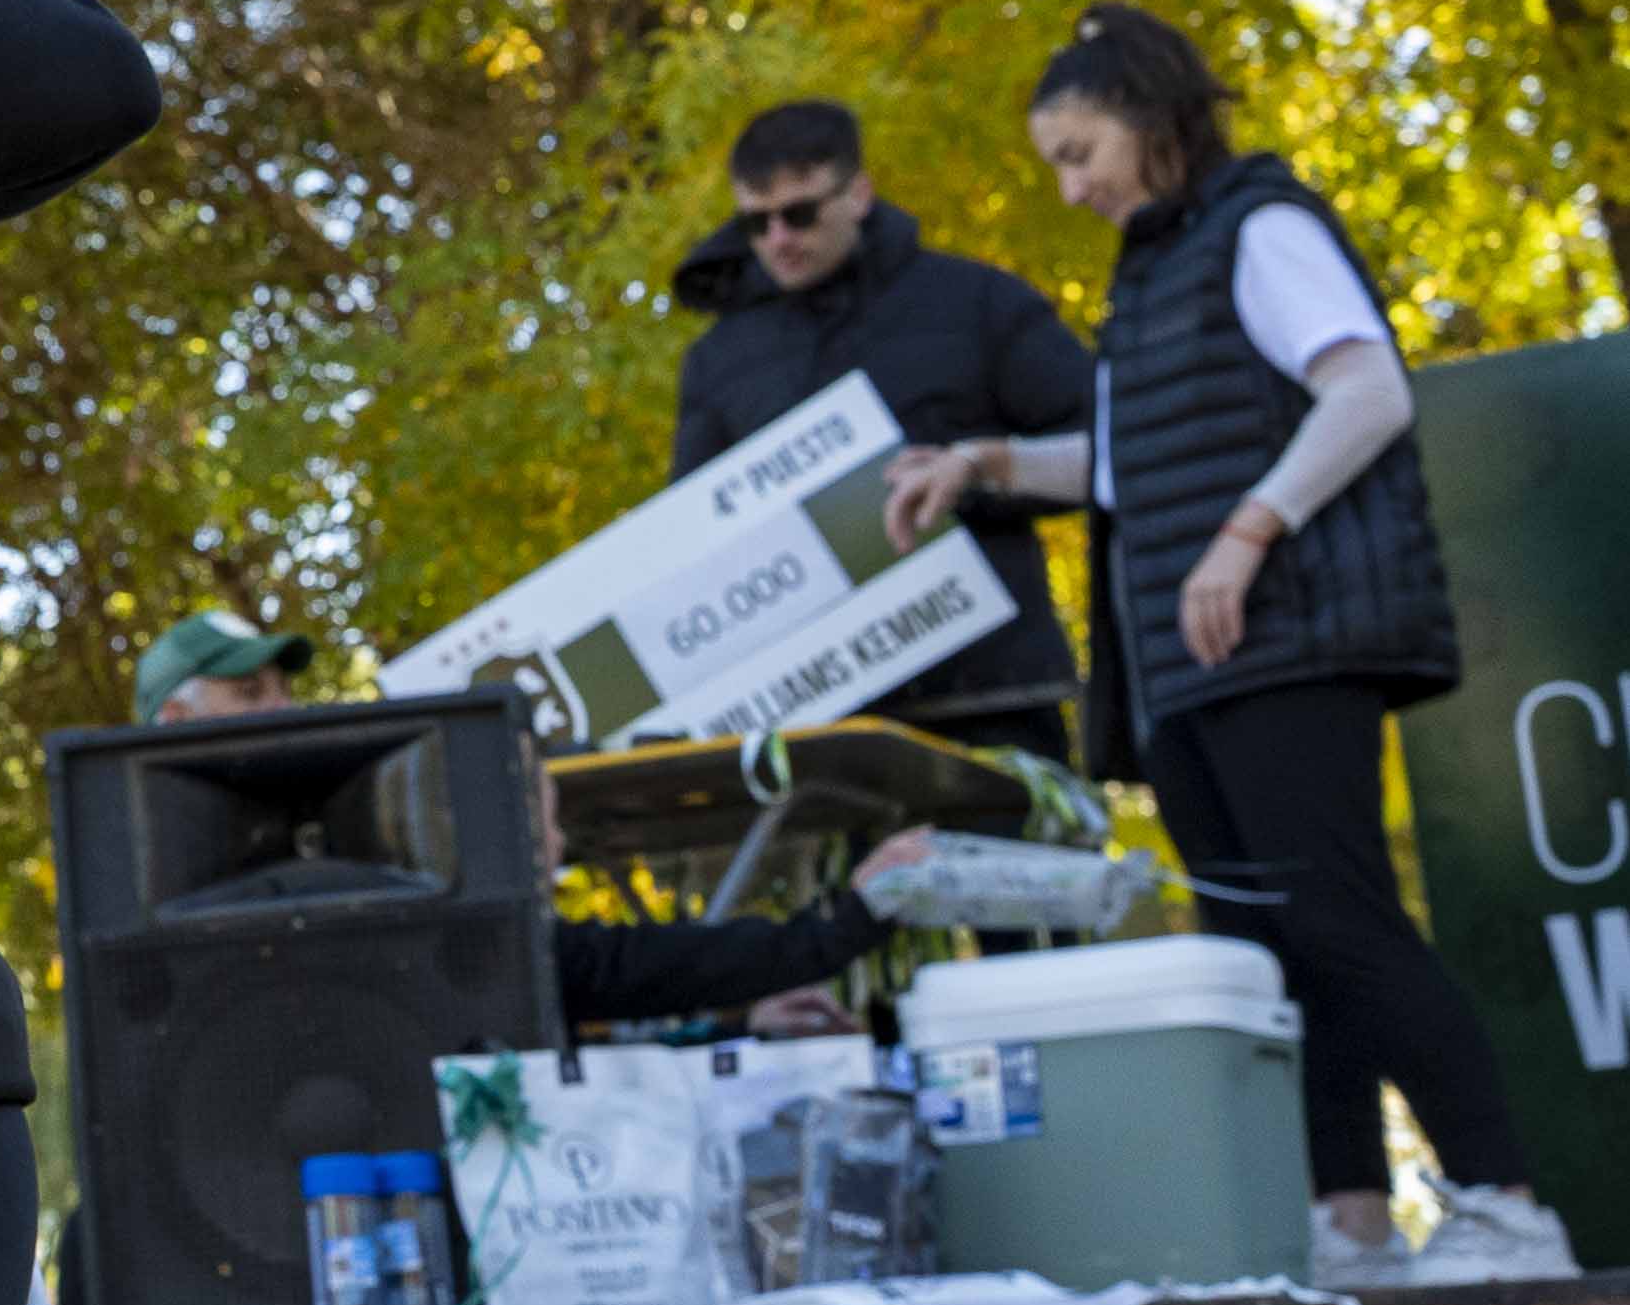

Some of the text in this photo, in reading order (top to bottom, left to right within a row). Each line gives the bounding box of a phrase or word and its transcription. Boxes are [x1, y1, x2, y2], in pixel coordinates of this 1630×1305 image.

[748, 411, 854, 494] PUESTO
[665, 552, 806, 657] 60.000
[846, 575, 977, 669] KEMMIS
